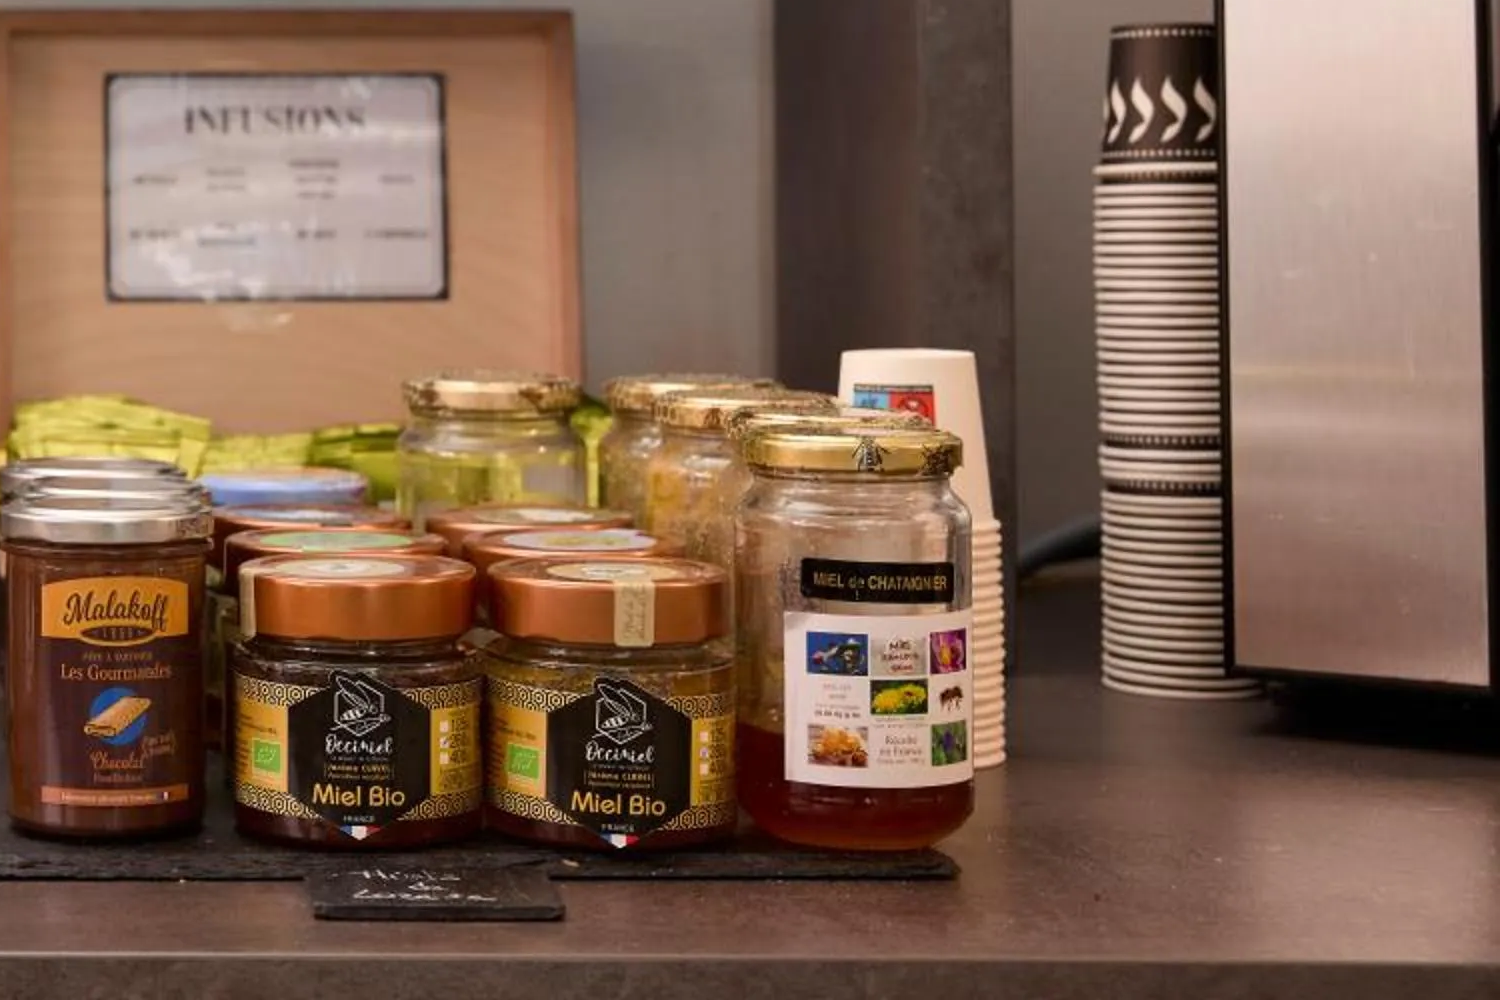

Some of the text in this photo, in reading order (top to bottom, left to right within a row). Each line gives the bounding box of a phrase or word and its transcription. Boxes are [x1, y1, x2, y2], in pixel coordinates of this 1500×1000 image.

[185, 105, 366, 134] INFUSIONS
[813, 571, 948, 591] MIEL de CHATAIGNIER
[63, 589, 169, 633] Malakoff
[61, 661, 173, 682] Les Gourmandes
[312, 782, 406, 807] Miel Bio
[571, 789, 666, 817] Miel Bio
